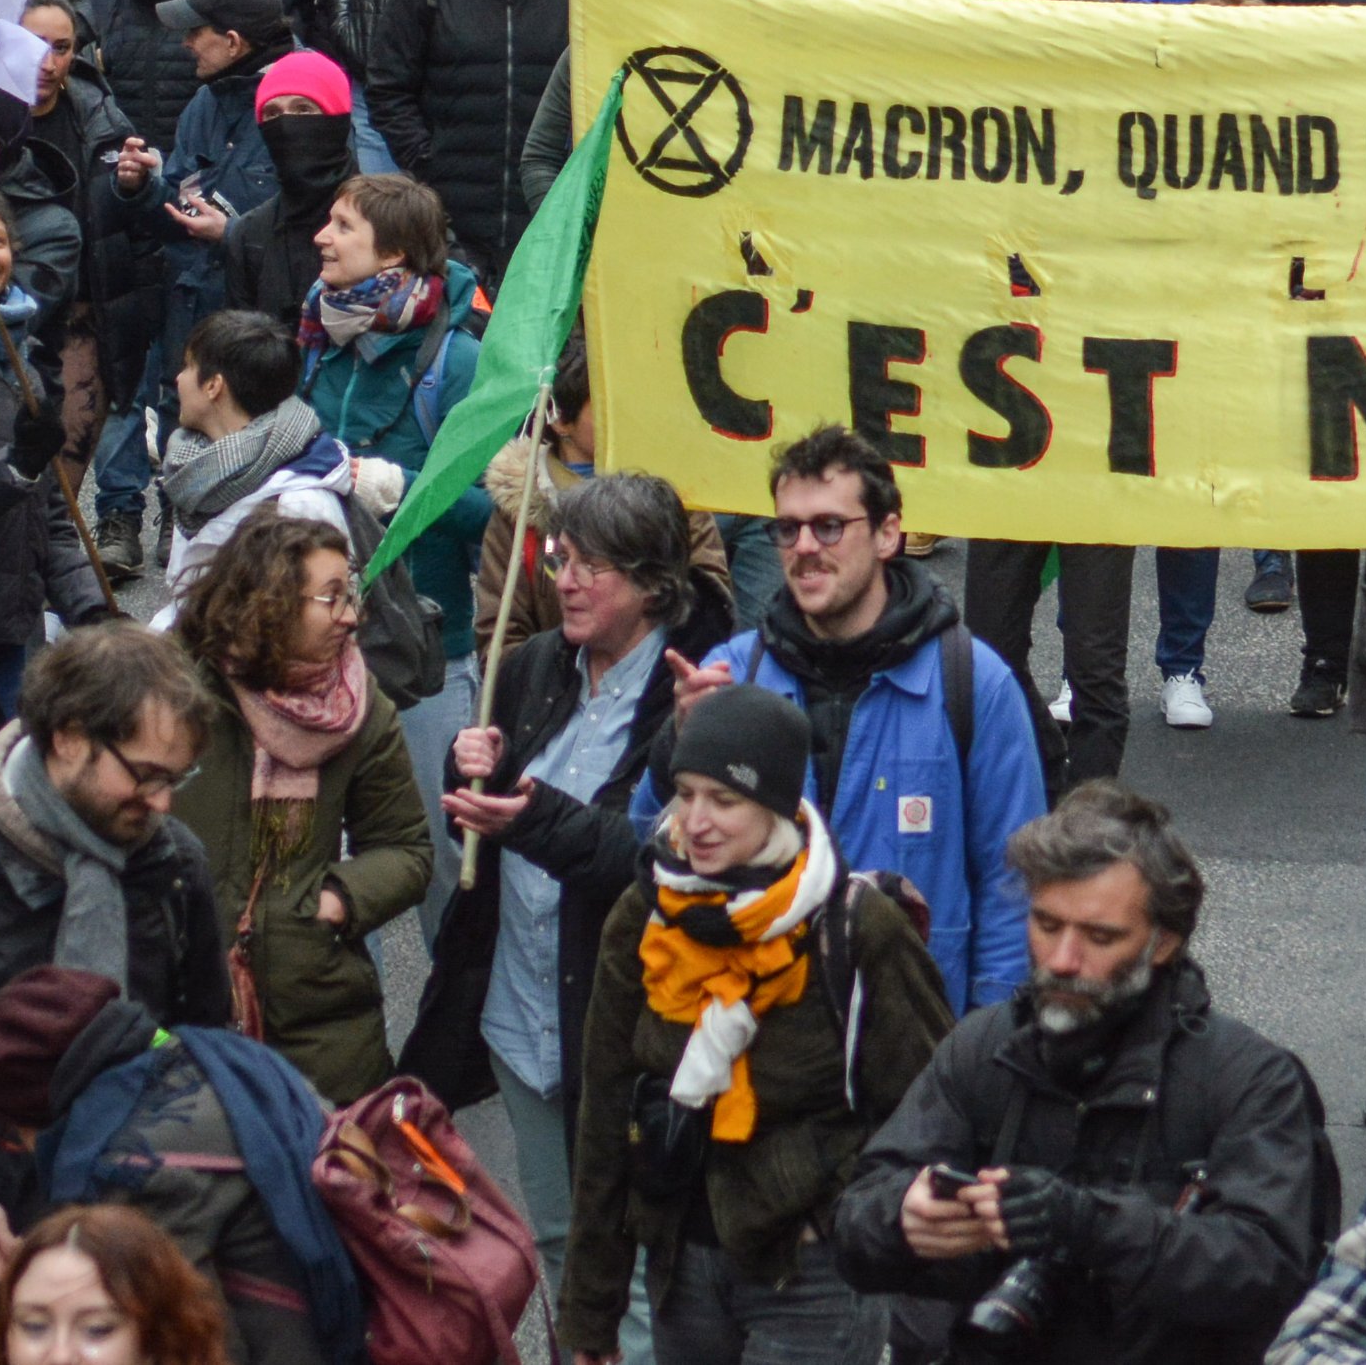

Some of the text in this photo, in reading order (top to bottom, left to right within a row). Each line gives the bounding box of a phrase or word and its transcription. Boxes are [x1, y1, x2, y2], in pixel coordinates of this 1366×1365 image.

[778, 95, 1085, 196] MACRON,
[1117, 112, 1340, 199] QUAND
[681, 287, 1179, 477] C'EST
